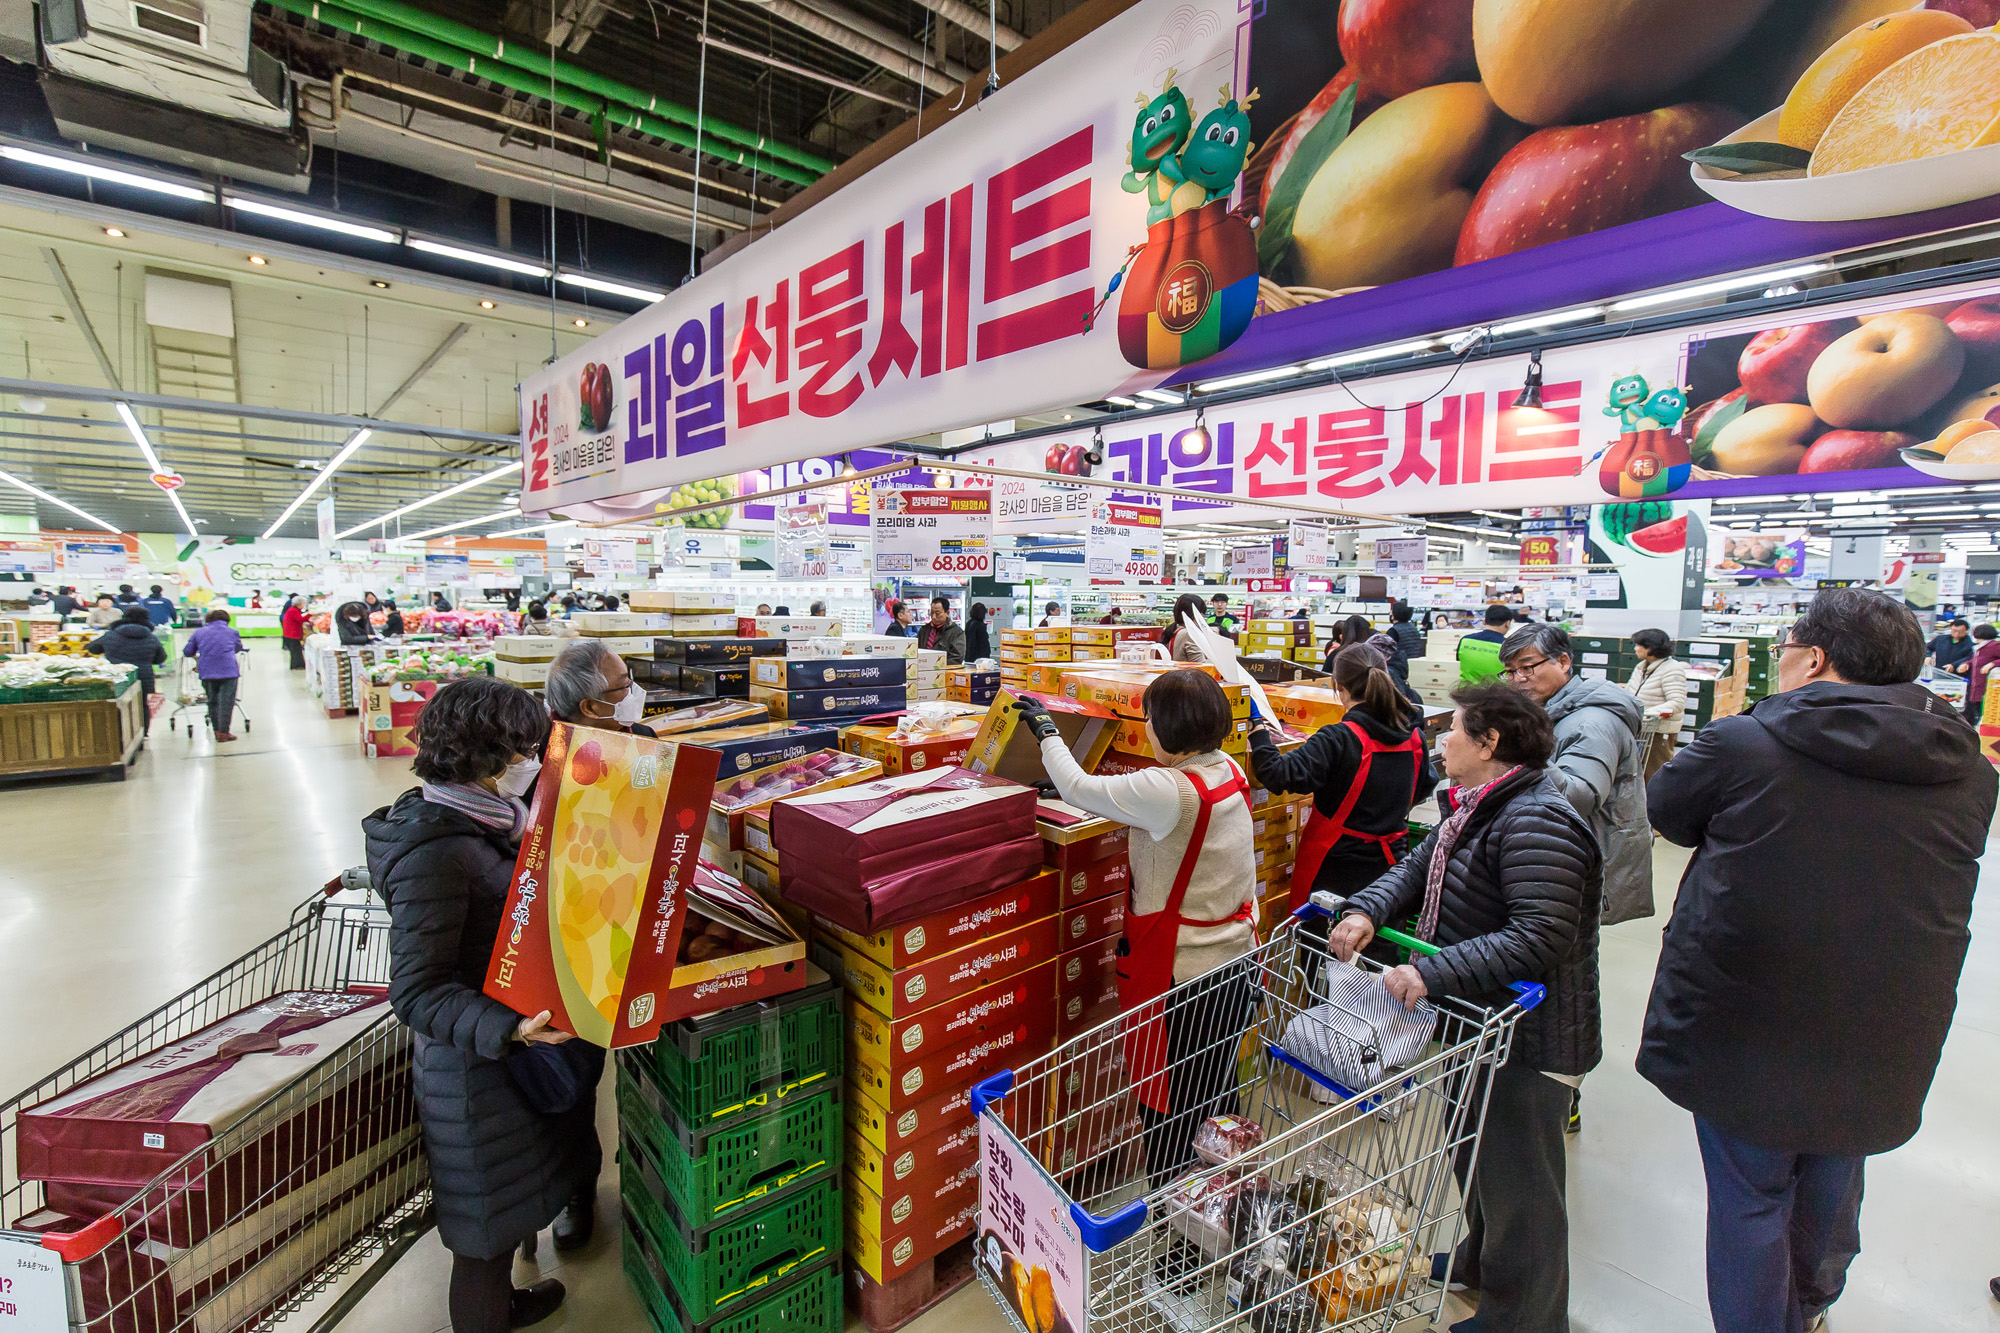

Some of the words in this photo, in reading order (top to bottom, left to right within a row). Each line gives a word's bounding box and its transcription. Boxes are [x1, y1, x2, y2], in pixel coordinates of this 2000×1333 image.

[624, 302, 726, 465] 과일
[732, 124, 1095, 429] 선물세트
[1167, 276, 1198, 318] 福
[529, 394, 548, 492] 설
[553, 423, 569, 446] 2024
[1106, 422, 1234, 511] 과일
[1244, 381, 1583, 499] 선물세트
[553, 450, 571, 475] 감사의
[573, 442, 595, 469] 마음을
[1633, 459, 1654, 477] 福
[1002, 482, 1025, 495] 2024
[877, 496, 885, 510] 설
[912, 496, 948, 507] 정부할인
[951, 500, 988, 511] 지원행사
[1000, 498, 1028, 516] 감사의
[1031, 496, 1062, 513] 마음을
[877, 517, 915, 527] 프리미엄
[917, 517, 937, 527] 사과
[1115, 509, 1138, 520] 정부할인
[1091, 525, 1116, 535] 한손과일
[1118, 528, 1130, 537] 사과
[802, 562, 826, 577] 71,800
[932, 555, 988, 572] 68,800
[1125, 562, 1159, 576] 49,800
[1305, 554, 1325, 564] 125,000
[1687, 546, 1703, 572] 과일
[1250, 663, 1264, 673] 사과
[1112, 693, 1129, 707] 사과
[1280, 706, 1295, 717] 사과
[525, 824, 544, 869] 프리미엄
[535, 849, 546, 871] 무주
[655, 920, 670, 954] 프리미엄
[670, 832, 689, 865] 사과
[948, 922, 969, 936] 프리미엄
[999, 900, 1017, 917] 사과
[652, 921, 660, 937] 무주
[495, 942, 519, 988] 사과
[725, 967, 747, 978] 프리미엄
[949, 969, 970, 983] 프리미엄
[999, 945, 1017, 961] 사과
[728, 975, 748, 989] 사과
[946, 1017, 967, 1032] 프리미엄
[996, 991, 1014, 1008] 사과
[946, 1059, 967, 1073] 프리미엄
[996, 1031, 1014, 1048] 사과
[987, 1134, 1013, 1182] 강화
[988, 1166, 1026, 1226] 속노랑
[987, 1191, 1026, 1256] 고구마
